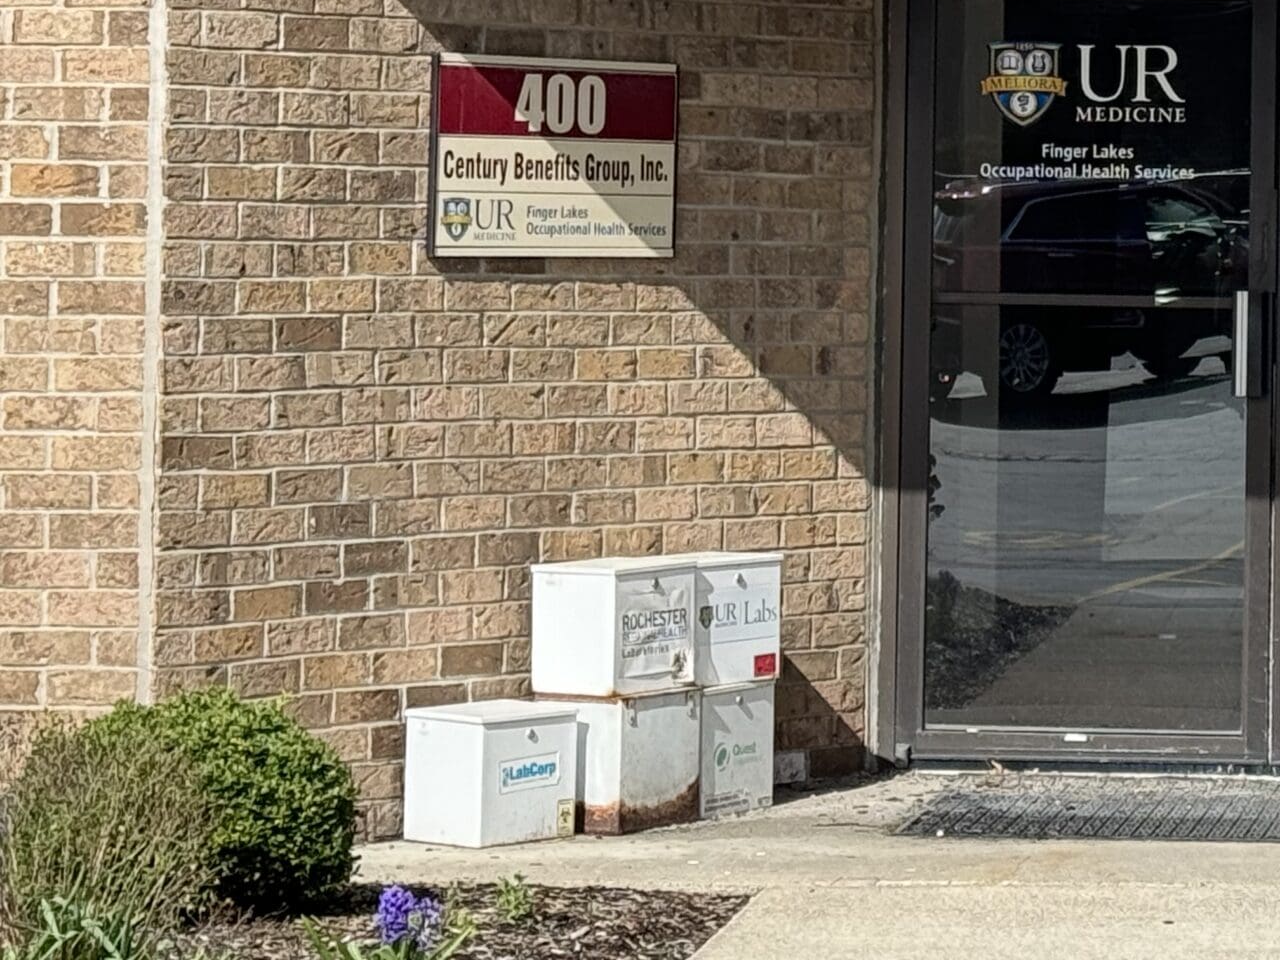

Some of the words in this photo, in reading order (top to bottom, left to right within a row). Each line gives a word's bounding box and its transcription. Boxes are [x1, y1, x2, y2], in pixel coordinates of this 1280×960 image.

[1076, 43, 1186, 103] UR
[990, 78, 1059, 90] MELIORA
[514, 73, 606, 135] 400
[1075, 106, 1187, 123] MEDICINE
[1041, 143, 1088, 162] Finger
[1092, 144, 1134, 159] Lakes
[443, 149, 508, 186] Century
[514, 152, 580, 181] Benefits
[585, 153, 635, 188] Group,
[640, 154, 668, 182] Inc.
[980, 162, 1077, 181] Occupational
[1081, 163, 1130, 179] Health
[1134, 164, 1195, 180] Services
[475, 199, 516, 230] UR
[526, 205, 558, 222] Finger
[561, 205, 589, 218] Lakes
[473, 232, 517, 241] MEDICINE
[526, 222, 591, 238] Occupational
[594, 222, 625, 236] Health
[628, 223, 667, 236] Services
[622, 607, 687, 631] ROCHESTER
[715, 602, 737, 622] UR
[744, 598, 777, 625] Labs
[510, 762, 556, 780] LabCorp
